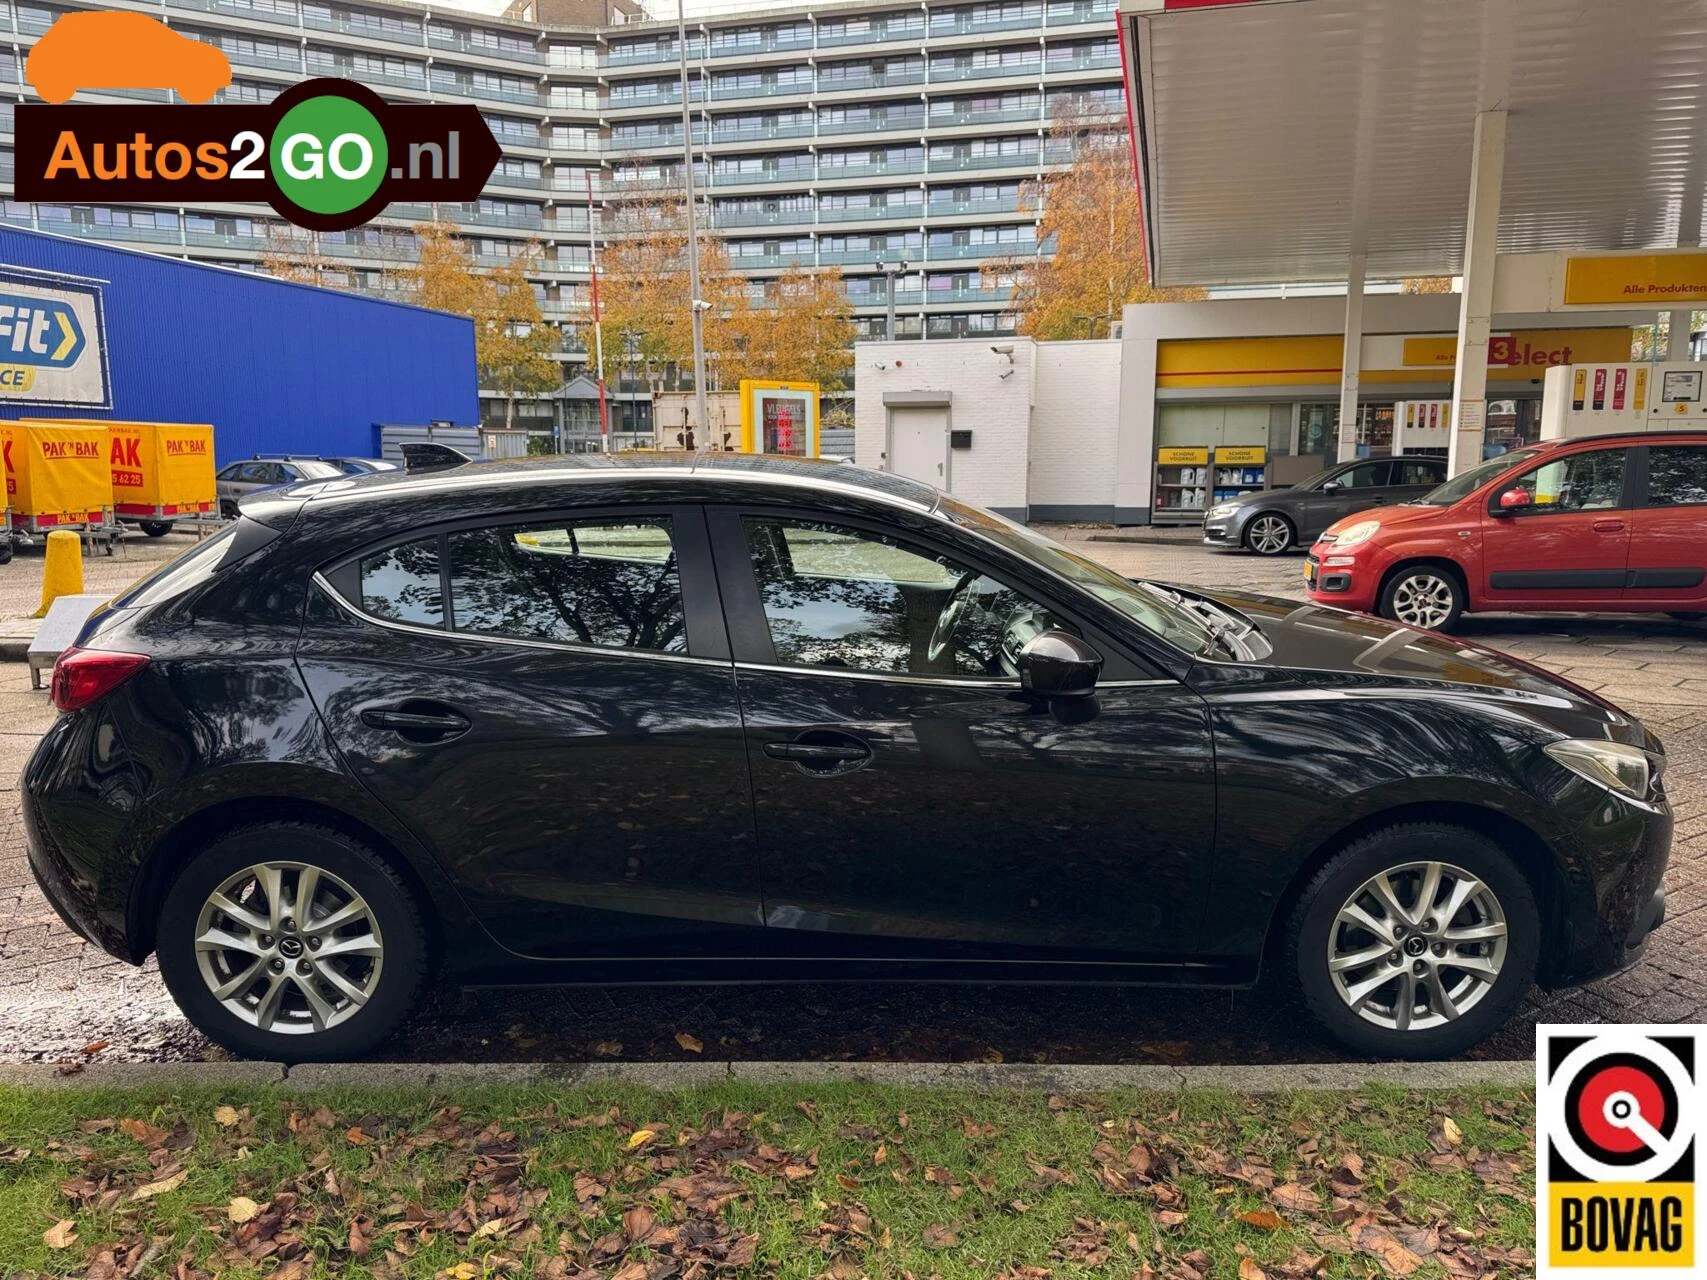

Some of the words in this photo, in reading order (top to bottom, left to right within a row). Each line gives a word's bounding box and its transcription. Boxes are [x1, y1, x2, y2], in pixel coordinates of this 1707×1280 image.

[1623, 284, 1645, 294] Alle
[1648, 283, 1706, 293] Produkten
[1494, 341, 1510, 360] 3
[1510, 343, 1573, 366] elect
[42, 441, 67, 456] PAK
[75, 441, 99, 456] BAK
[110, 437, 142, 467] AK
[166, 440, 184, 453] PAK
[189, 440, 206, 453] BAK
[130, 474, 141, 485] 25
